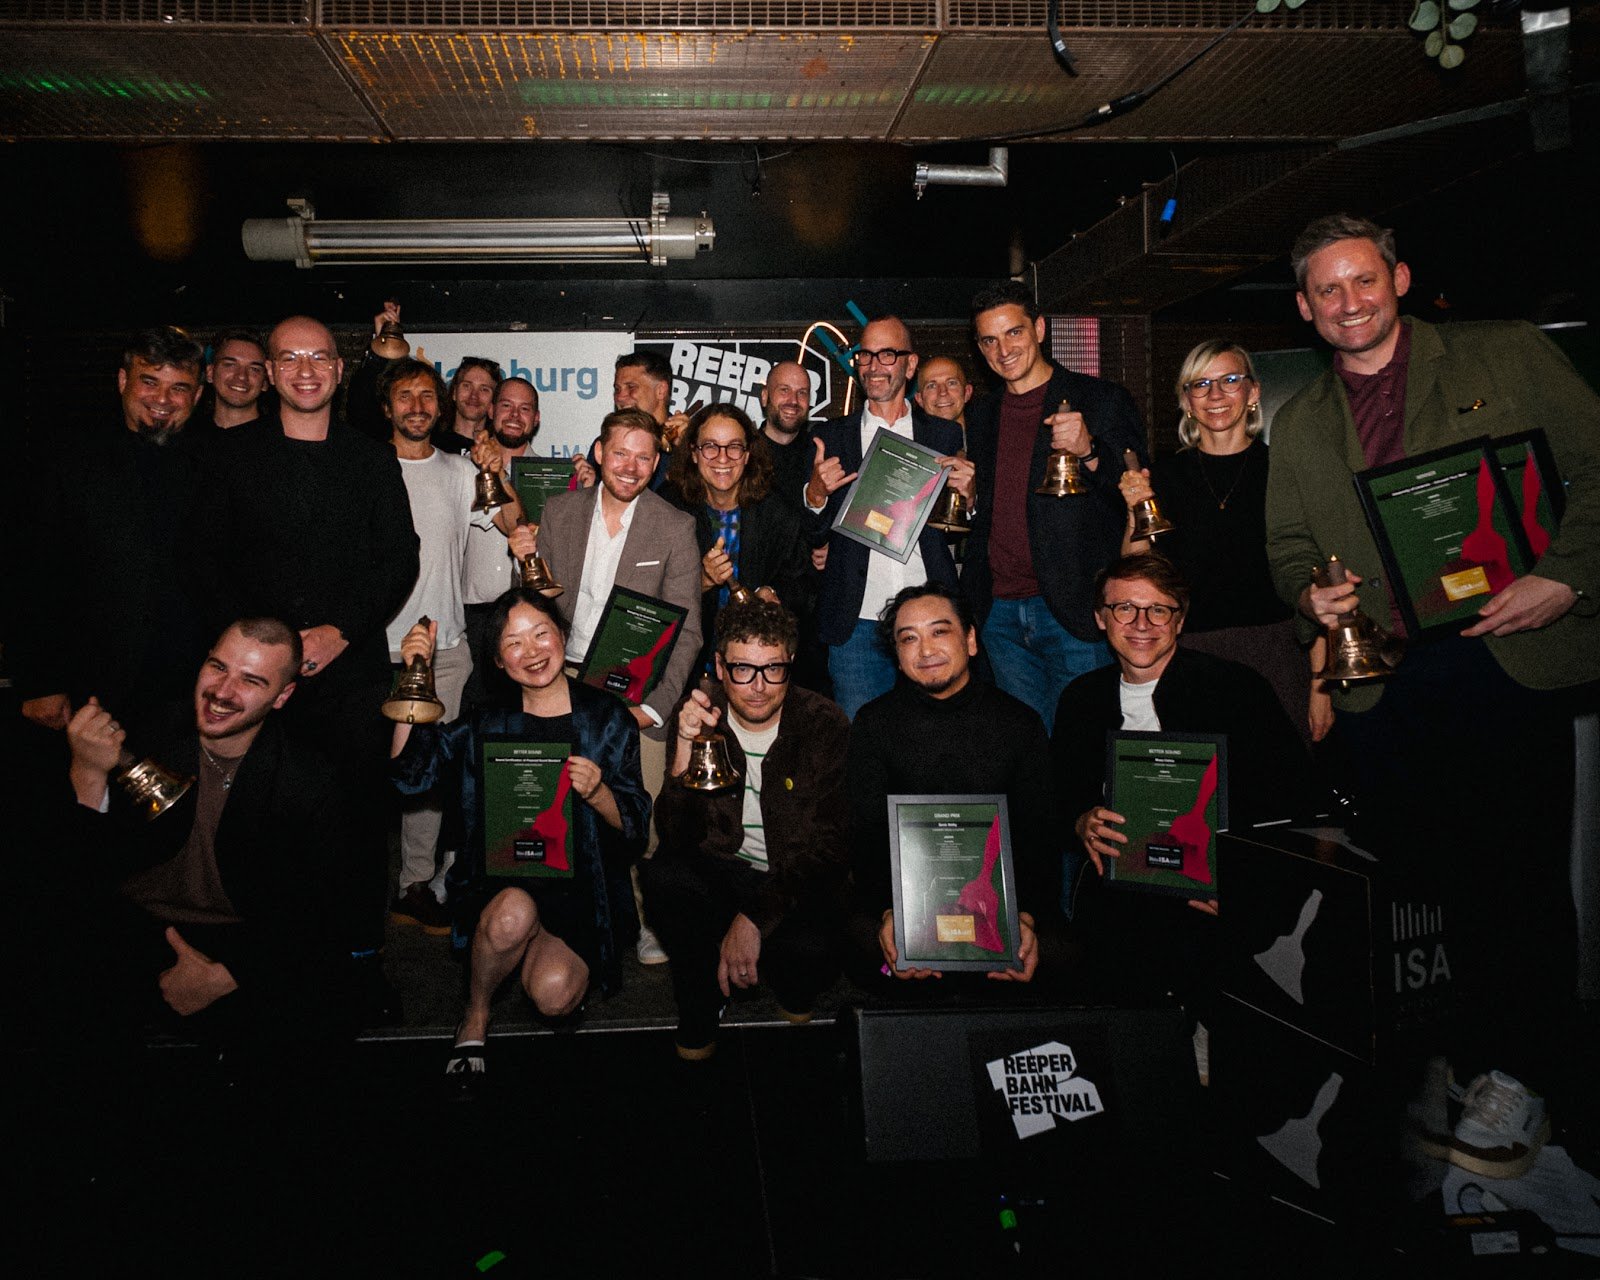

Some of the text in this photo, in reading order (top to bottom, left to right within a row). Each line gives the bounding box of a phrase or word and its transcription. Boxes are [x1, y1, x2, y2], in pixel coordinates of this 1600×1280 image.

[669, 342, 821, 407] REEPR
[1394, 943, 1452, 993] ISA
[1003, 1053, 1073, 1075] REEPER
[1006, 1074, 1058, 1095] BAHN
[1008, 1093, 1096, 1116] FESTIVAL
